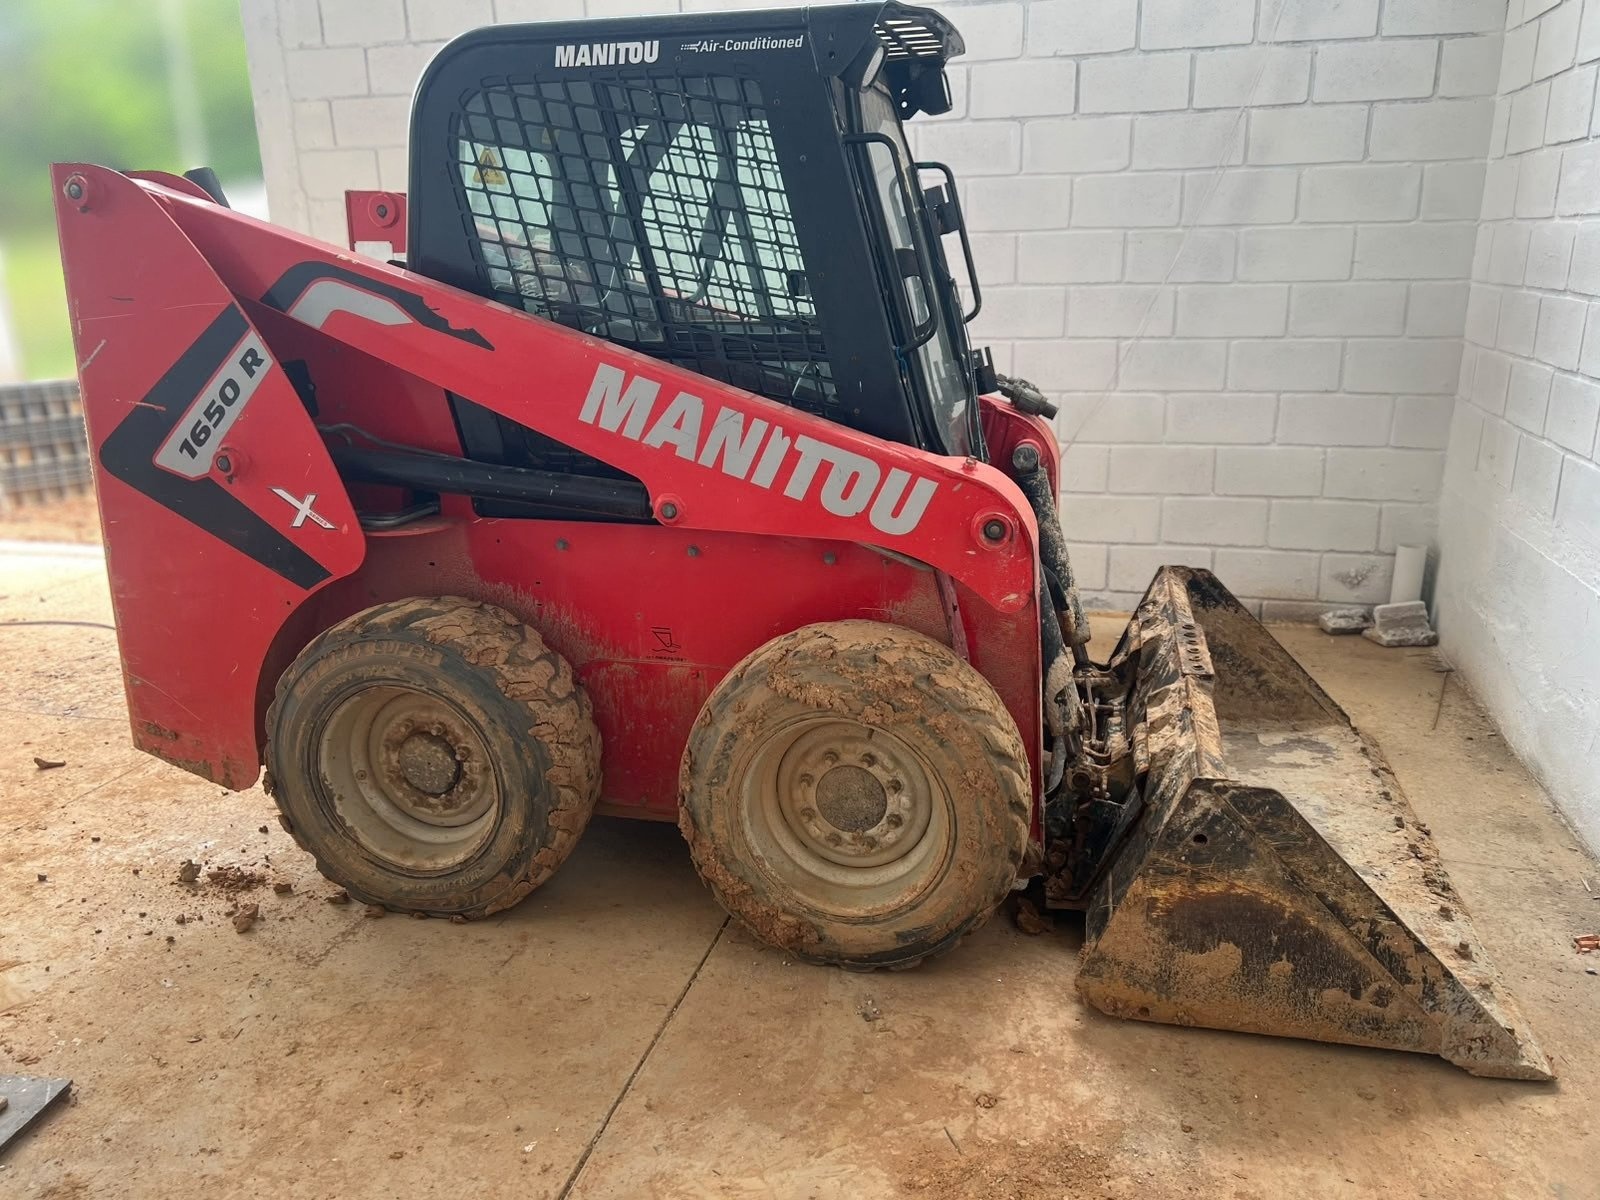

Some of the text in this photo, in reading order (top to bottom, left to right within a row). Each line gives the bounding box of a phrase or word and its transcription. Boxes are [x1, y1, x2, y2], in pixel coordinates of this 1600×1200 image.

[554, 40, 660, 68] MANITOU
[701, 35, 804, 53] Air-Conditioned
[178, 347, 265, 460] 1650 R
[578, 362, 939, 536] MANITOU
